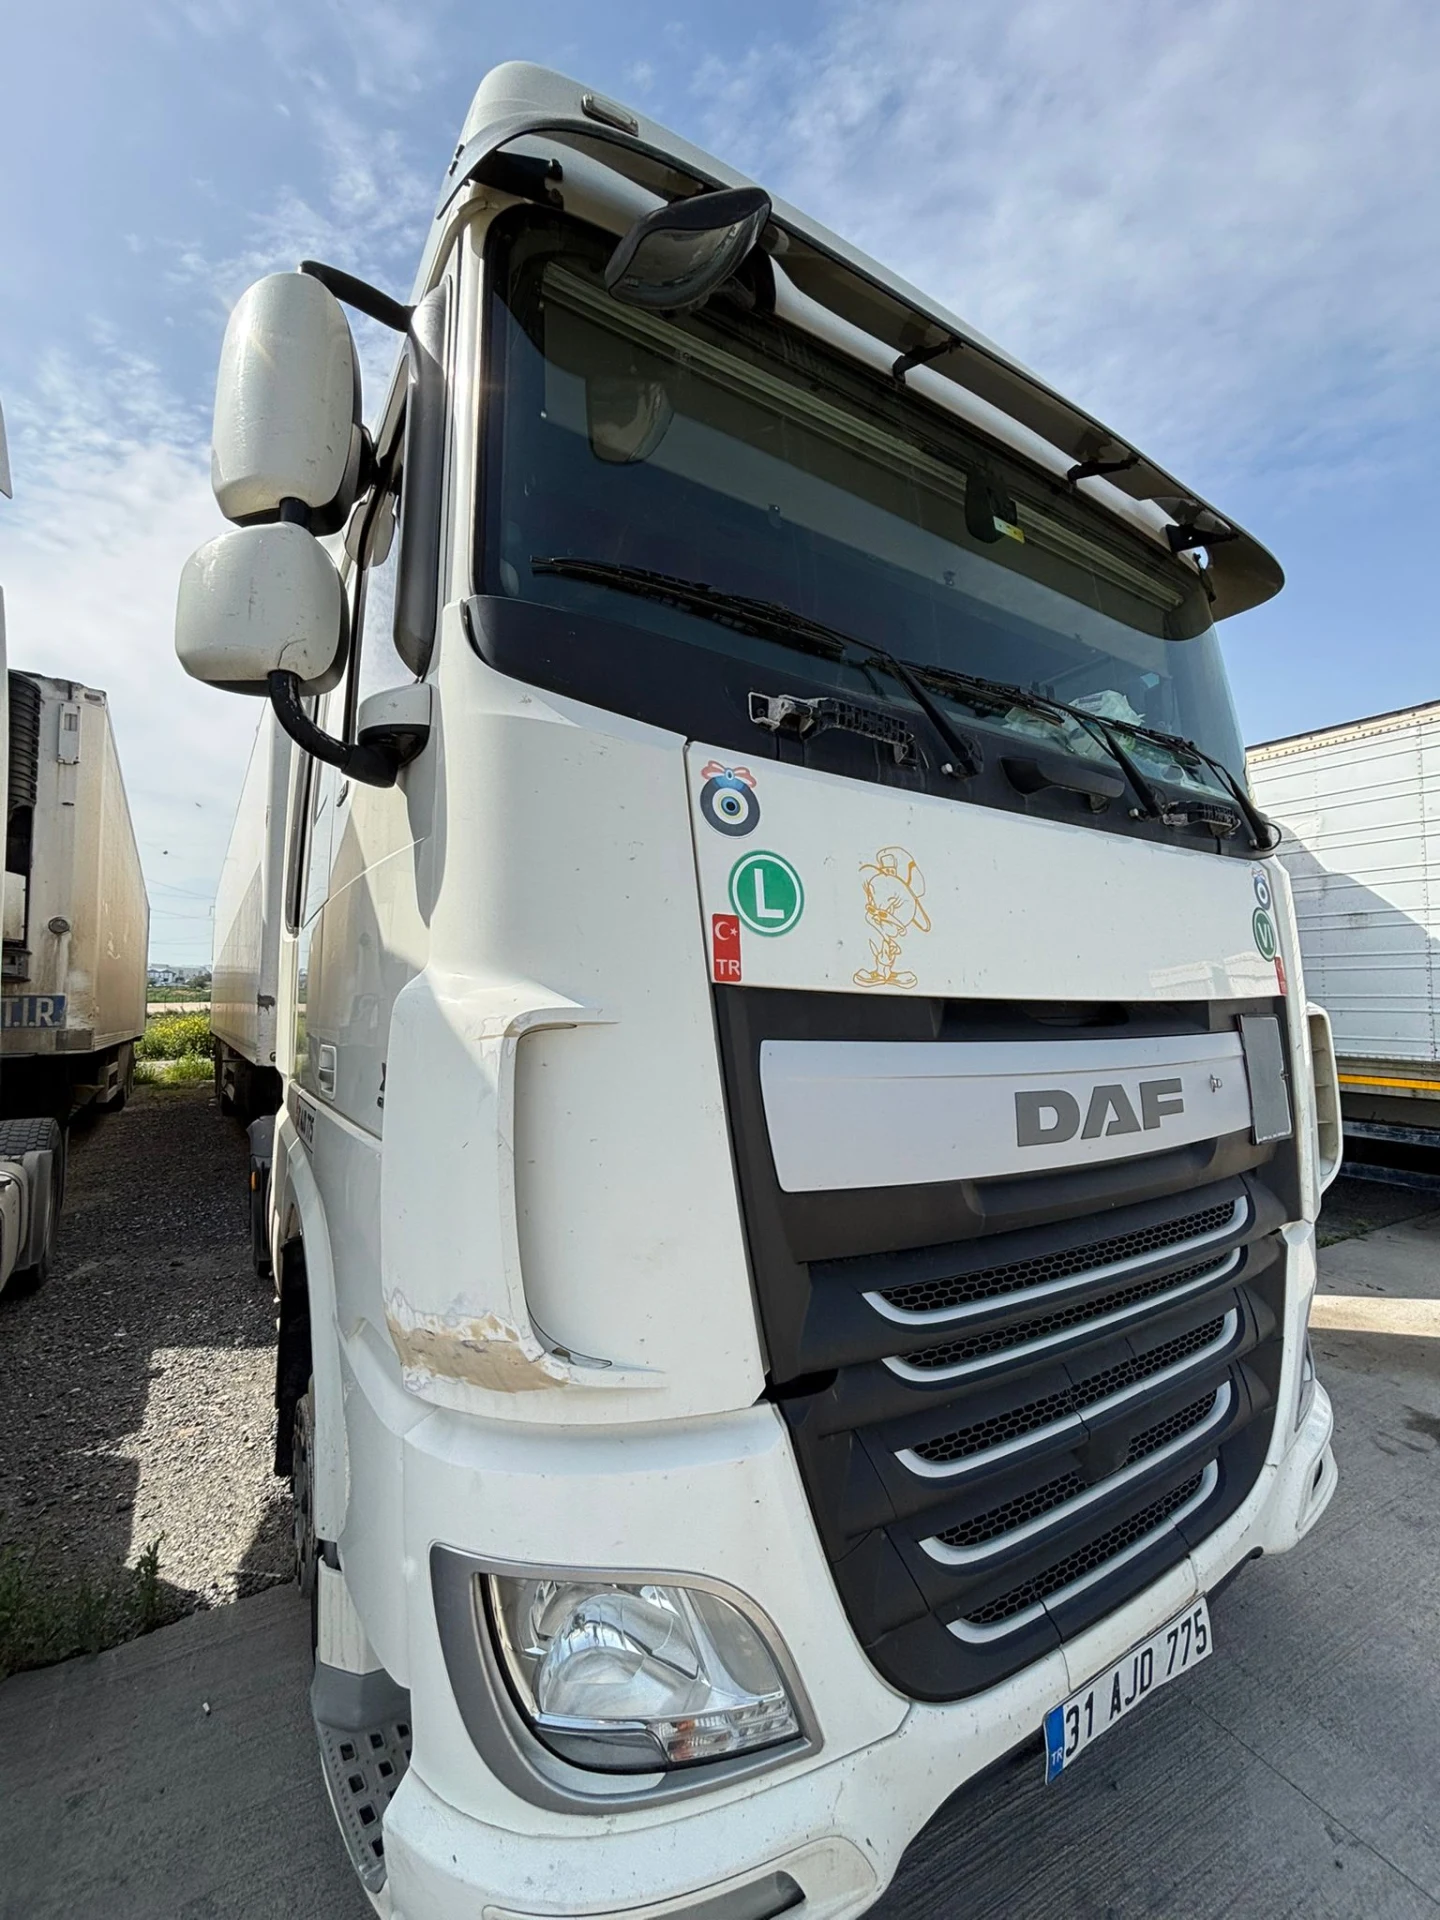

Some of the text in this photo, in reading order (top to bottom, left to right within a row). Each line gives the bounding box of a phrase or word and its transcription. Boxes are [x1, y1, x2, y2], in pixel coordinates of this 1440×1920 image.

[754, 868, 785, 919] L
[1257, 922, 1274, 949] VI
[715, 958, 741, 976] TR
[1, 997, 61, 1027] T.I.R.
[1014, 1077, 1185, 1147] DAF
[1065, 1607, 1208, 1759] 31 AJD 775
[1051, 1747, 1063, 1766] TR
